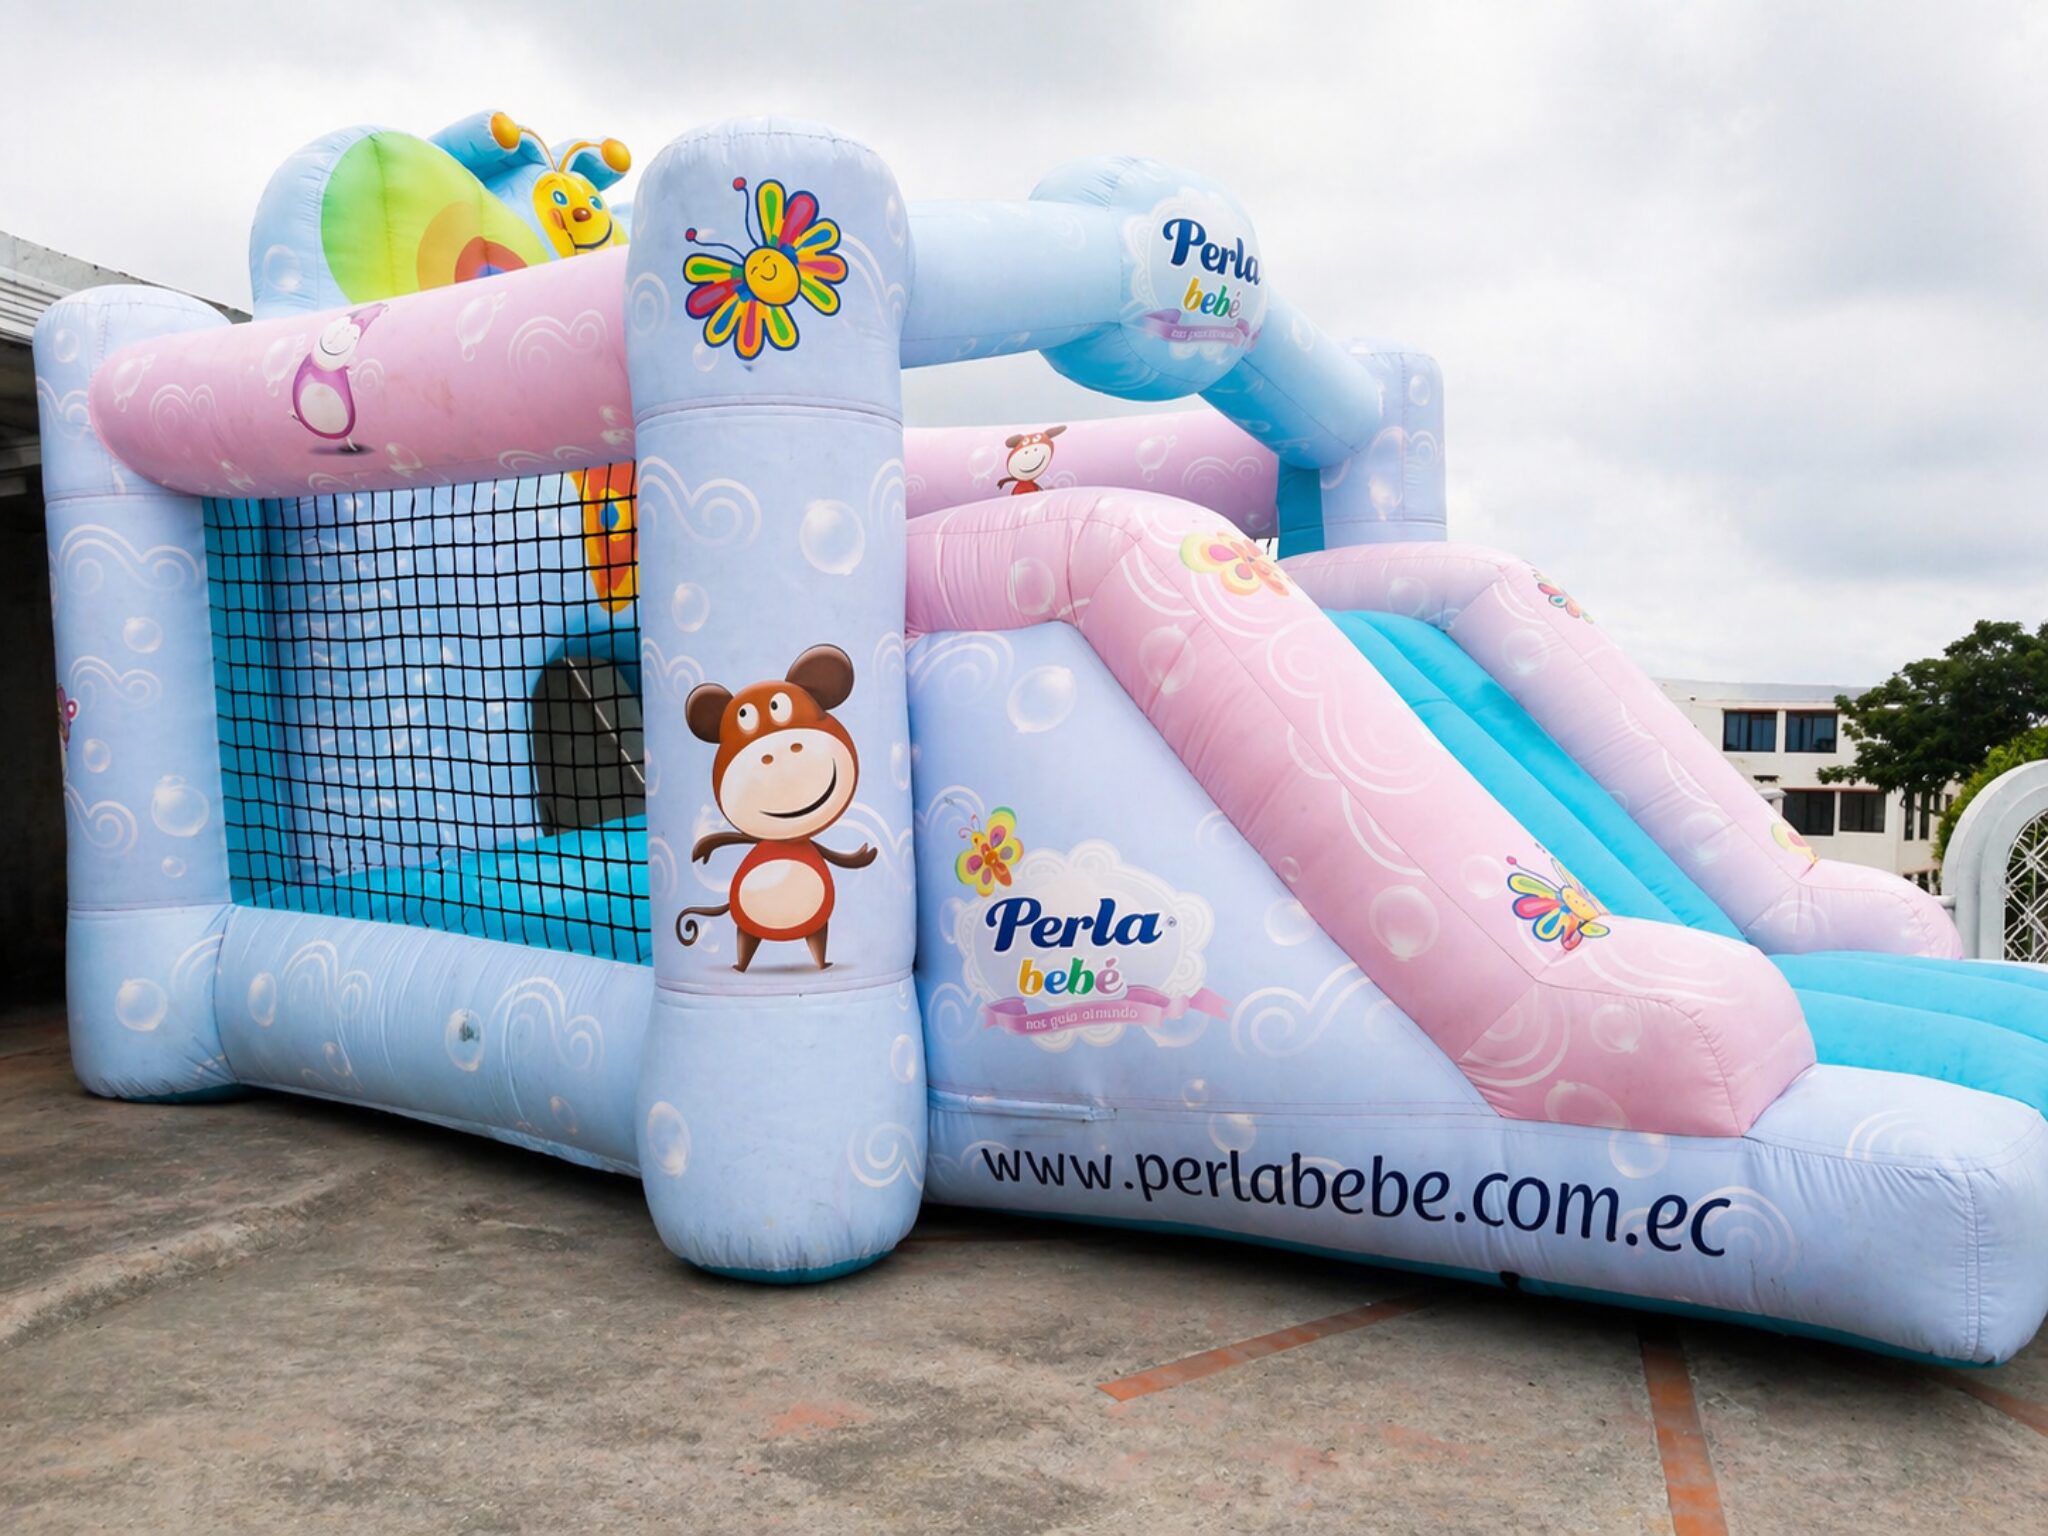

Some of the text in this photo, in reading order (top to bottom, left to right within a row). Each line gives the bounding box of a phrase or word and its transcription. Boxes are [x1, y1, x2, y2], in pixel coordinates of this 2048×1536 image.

[1162, 218, 1261, 286] Perla
[1183, 277, 1241, 319] bebé
[985, 897, 1163, 953] Perla
[1018, 957, 1123, 995] bebé
[981, 1148, 1732, 1257] www.perlabebe.com.ec
